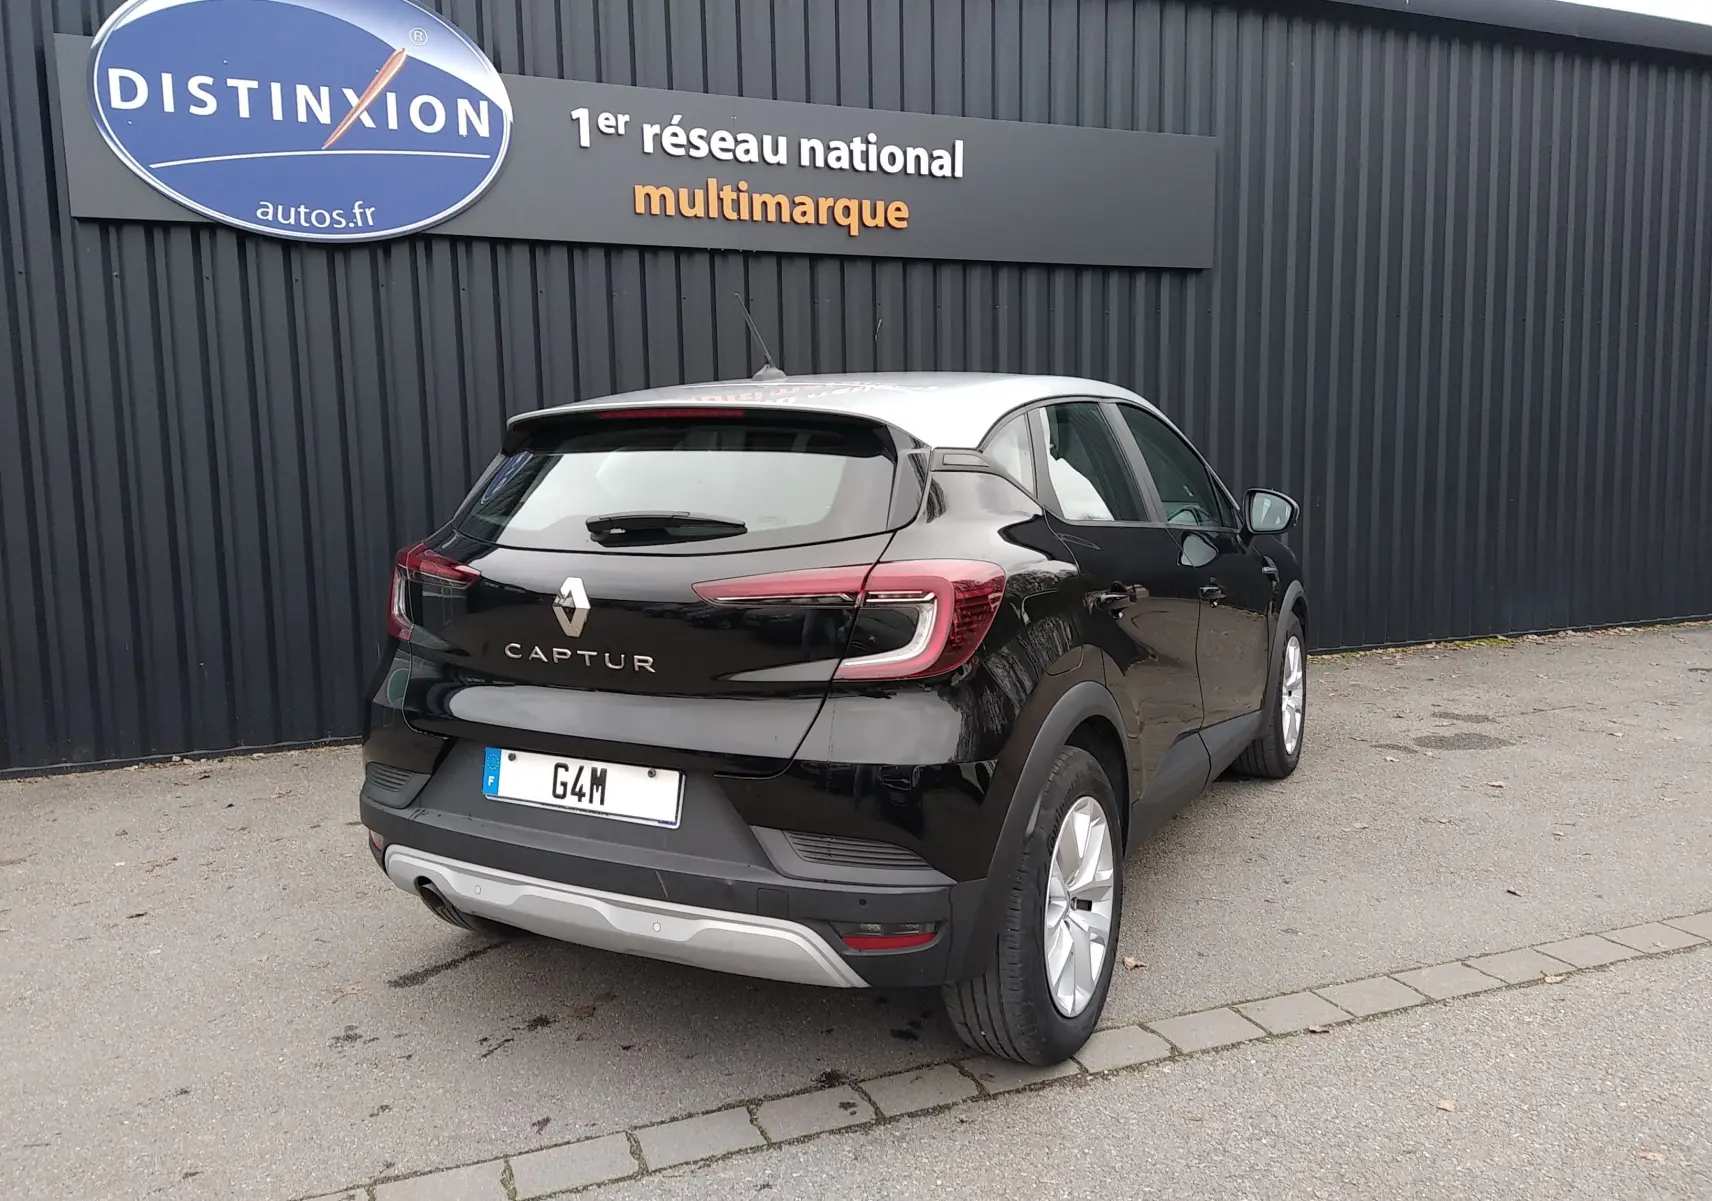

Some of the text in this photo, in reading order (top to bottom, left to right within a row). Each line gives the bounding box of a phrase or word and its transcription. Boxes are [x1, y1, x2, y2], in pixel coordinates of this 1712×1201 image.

[107, 47, 491, 149] DISTINXION
[570, 107, 964, 178] 1er réseau national
[256, 200, 376, 228] autos.fr
[634, 177, 910, 236] multimarque
[504, 642, 656, 673] CAPTUR
[487, 762, 608, 806] F G4M
